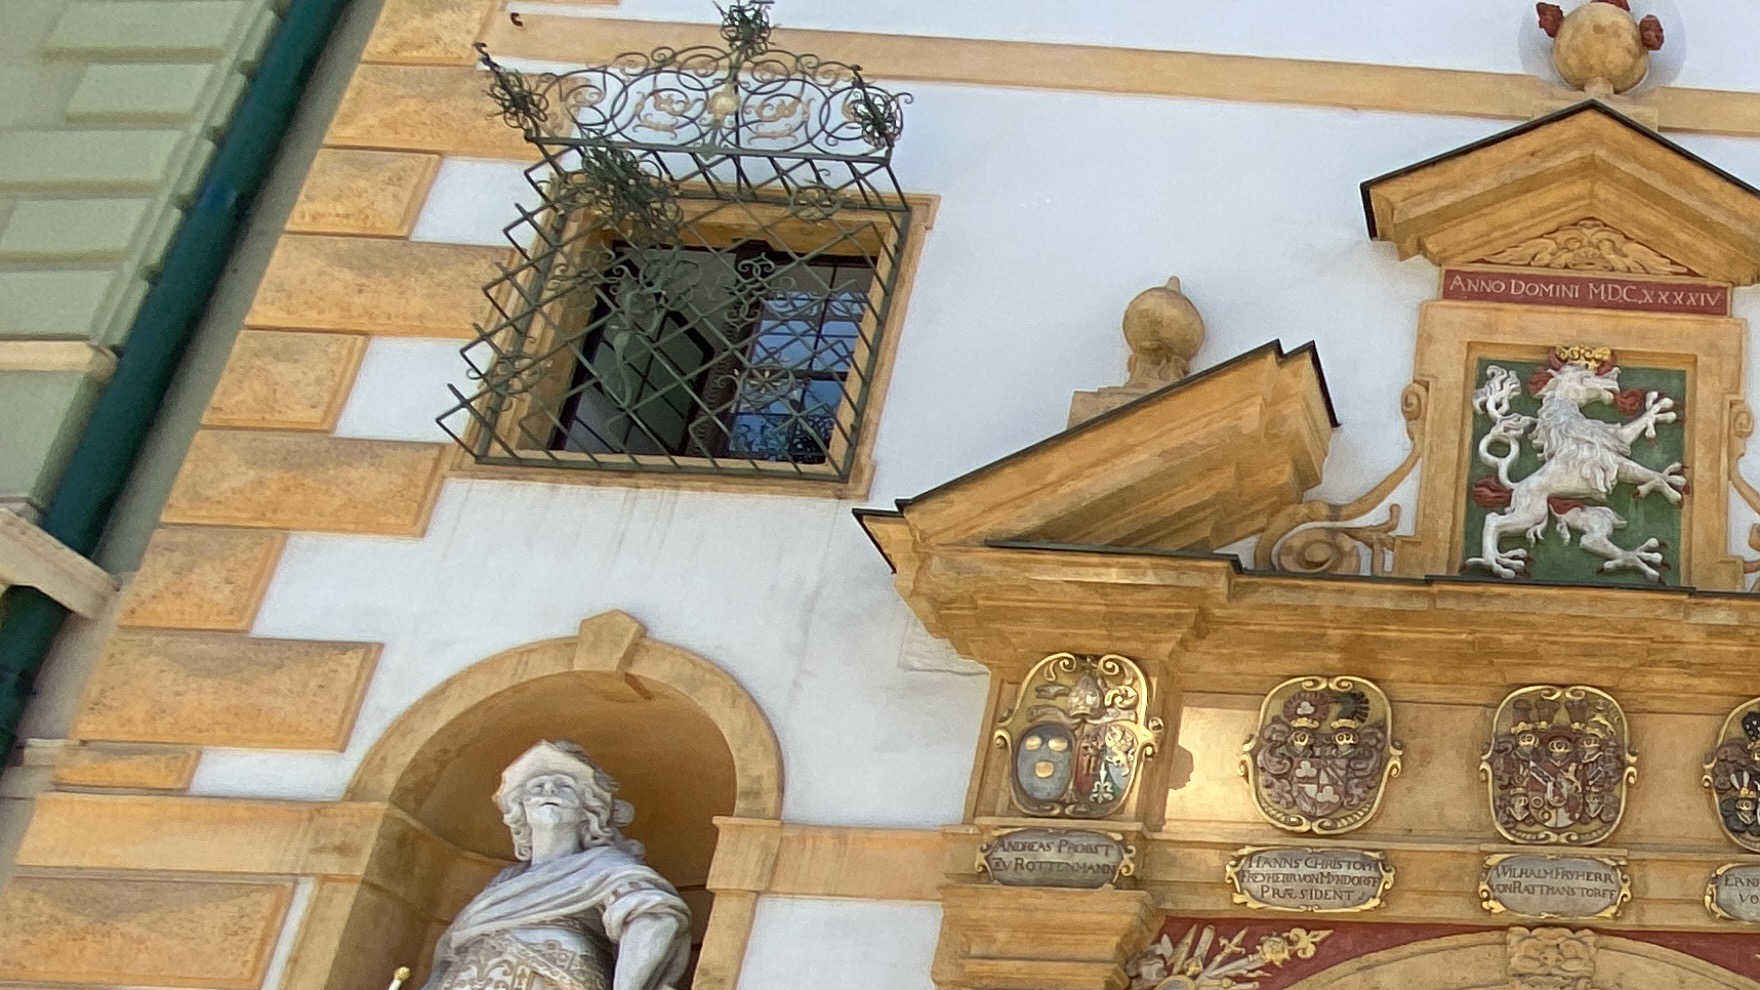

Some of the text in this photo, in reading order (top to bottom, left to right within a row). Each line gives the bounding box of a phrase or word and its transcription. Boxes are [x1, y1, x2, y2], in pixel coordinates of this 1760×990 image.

[1448, 274, 1506, 294] ANNO
[1509, 278, 1580, 299] DOMINI
[1057, 839, 1114, 857] PROBST
[1247, 855, 1302, 869] HANNS
